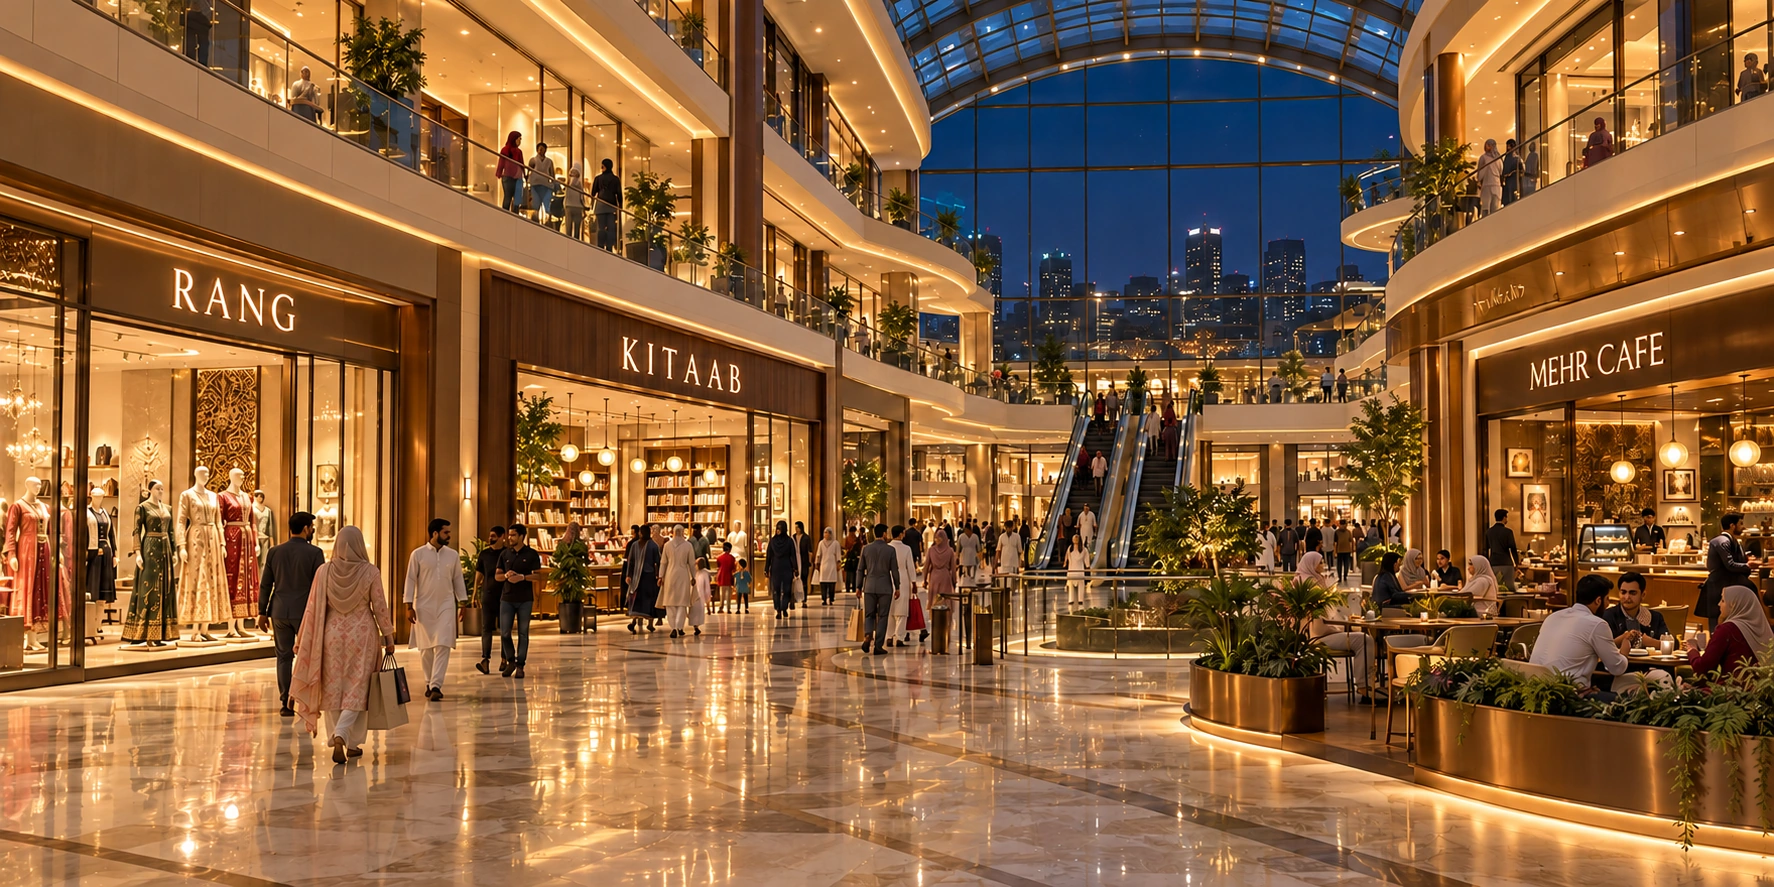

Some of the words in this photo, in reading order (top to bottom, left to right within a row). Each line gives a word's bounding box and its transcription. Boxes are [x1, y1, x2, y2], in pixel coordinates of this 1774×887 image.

[172, 267, 298, 333] RANG
[621, 335, 743, 395] KITAAB
[1529, 350, 1591, 391] MEHR
[1597, 331, 1665, 376] CAFE
